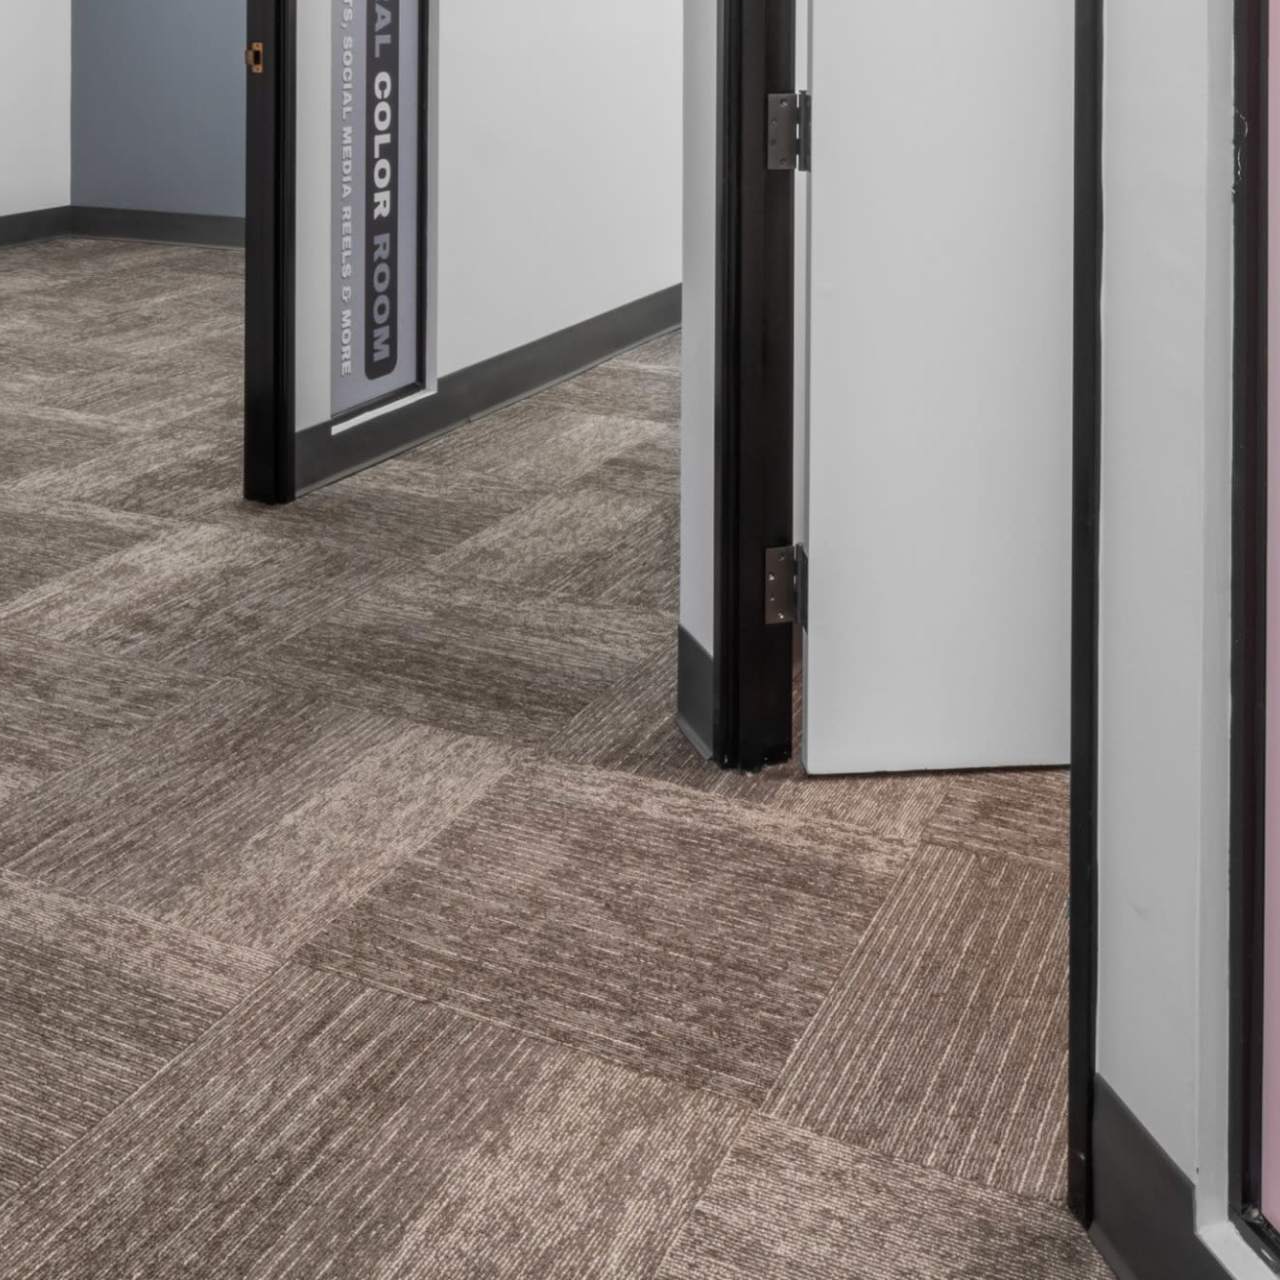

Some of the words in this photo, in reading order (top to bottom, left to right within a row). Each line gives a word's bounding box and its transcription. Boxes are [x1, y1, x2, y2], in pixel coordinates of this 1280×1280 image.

[341, 35, 354, 120] SOCIAL
[341, 125, 353, 199] MEDIA
[373, 70, 392, 221] COLOR
[340, 205, 353, 279] REELS
[340, 285, 352, 303] &
[372, 232, 391, 363] ROOM
[340, 308, 353, 377] MORE
